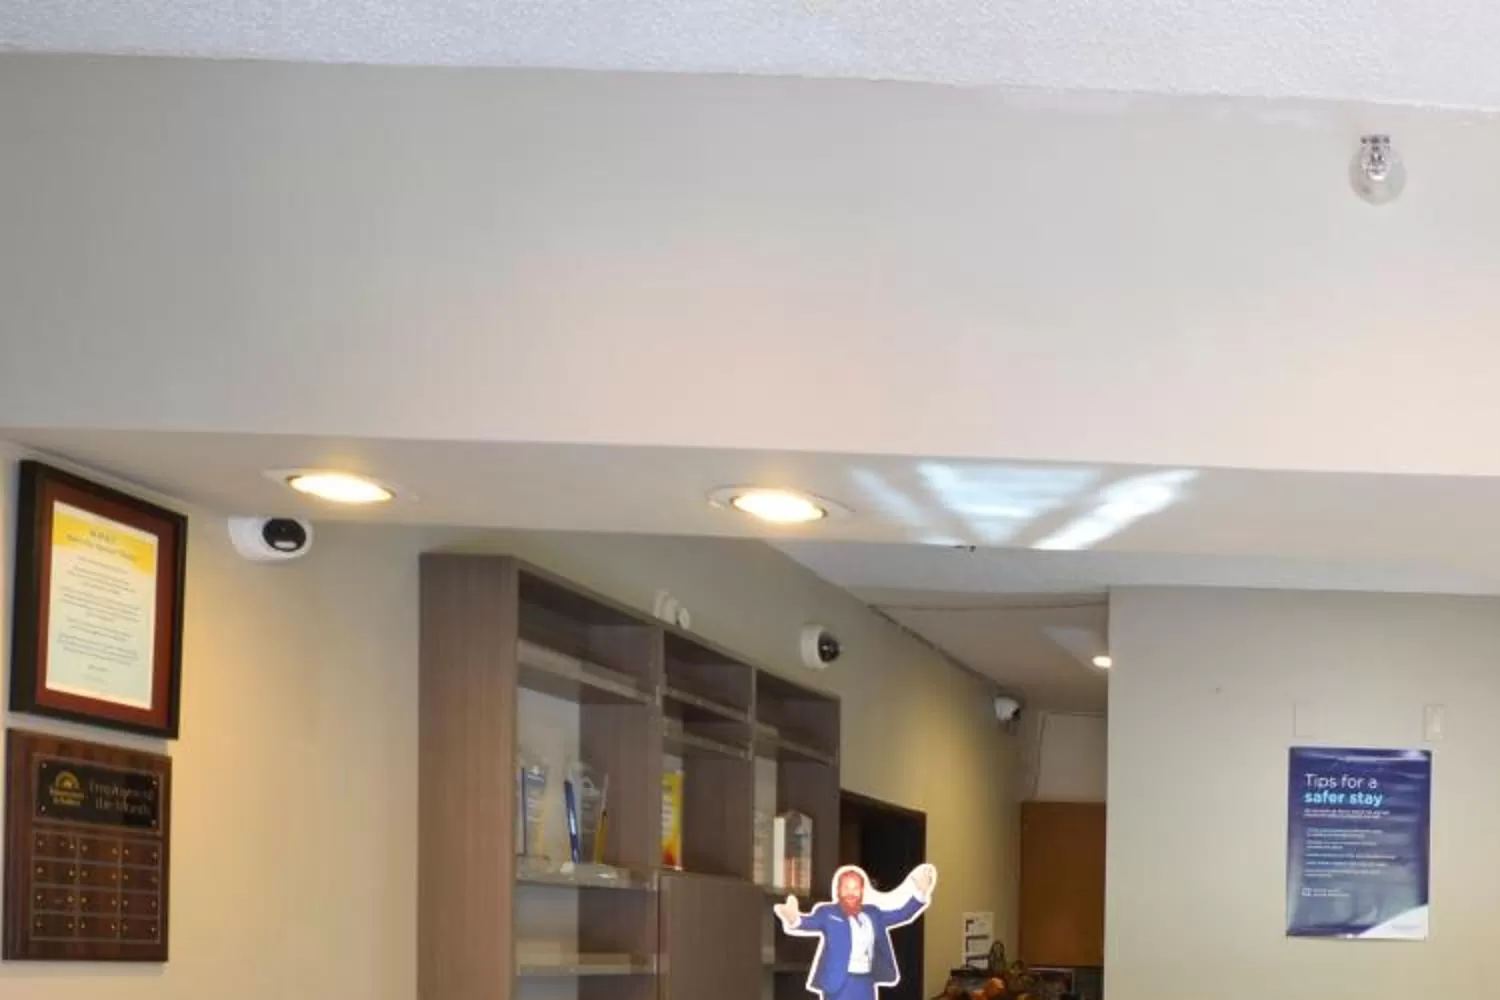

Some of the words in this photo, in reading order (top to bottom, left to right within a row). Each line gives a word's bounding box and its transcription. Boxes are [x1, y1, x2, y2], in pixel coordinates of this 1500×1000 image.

[1304, 773, 1337, 790] Tips
[1341, 774, 1364, 789] for
[1368, 777, 1378, 789] a
[1304, 790, 1345, 804] safer
[1350, 791, 1383, 807] stay
